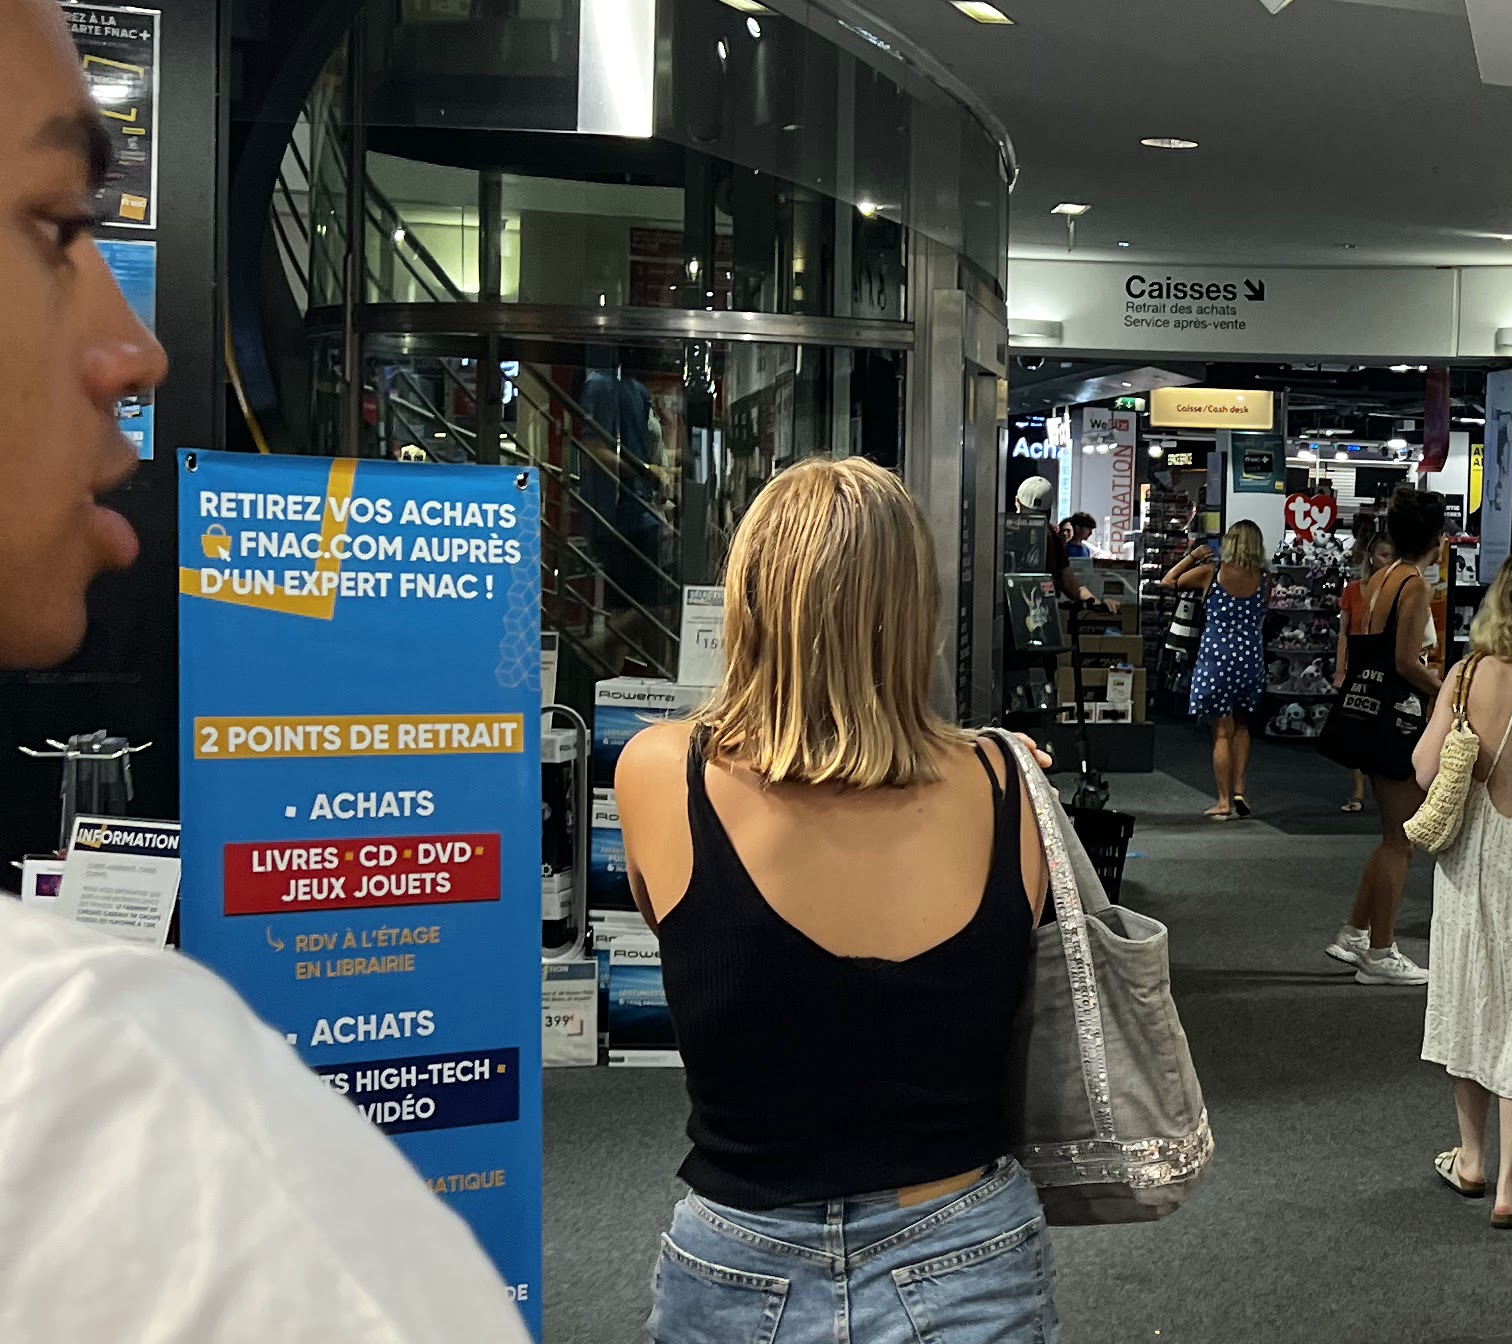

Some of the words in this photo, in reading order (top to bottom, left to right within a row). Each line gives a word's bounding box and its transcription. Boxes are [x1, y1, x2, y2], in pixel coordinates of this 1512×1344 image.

[1125, 275, 1237, 301] Caisses
[1124, 316, 1170, 328] Service
[1173, 317, 1247, 331] après-vente
[1126, 301, 1166, 314] Retrait
[1170, 302, 1192, 315] des
[1196, 303, 1237, 316] achats
[200, 491, 322, 522] RETIREZ
[327, 495, 393, 524] VOS
[400, 500, 517, 529] ACHATS
[1288, 496, 1332, 533] ty
[240, 531, 402, 562] FNAC.COM
[410, 532, 522, 565] AUPRÈS
[200, 567, 275, 596] D'UN
[283, 570, 393, 598] EXPERT
[400, 573, 479, 600] FNAC
[484, 574, 494, 600] !
[200, 726, 219, 753] 2
[228, 725, 342, 752] POINTS
[350, 724, 390, 751] DE
[398, 722, 518, 750] RETRAIT
[309, 789, 436, 821] ACHATS
[252, 847, 339, 873] LIVRES
[359, 844, 398, 868] CD
[417, 841, 473, 866] DVD
[282, 876, 347, 903] JEUX
[353, 871, 452, 898] JOUETS
[295, 931, 337, 953] RDV
[342, 926, 356, 950] À
[360, 924, 441, 949] L'ÉTAGE
[295, 959, 322, 981] EN
[326, 953, 416, 978] LIBRAIRIE
[311, 1009, 436, 1046] ACHATS
[354, 1058, 491, 1093] HIGH-TECH
